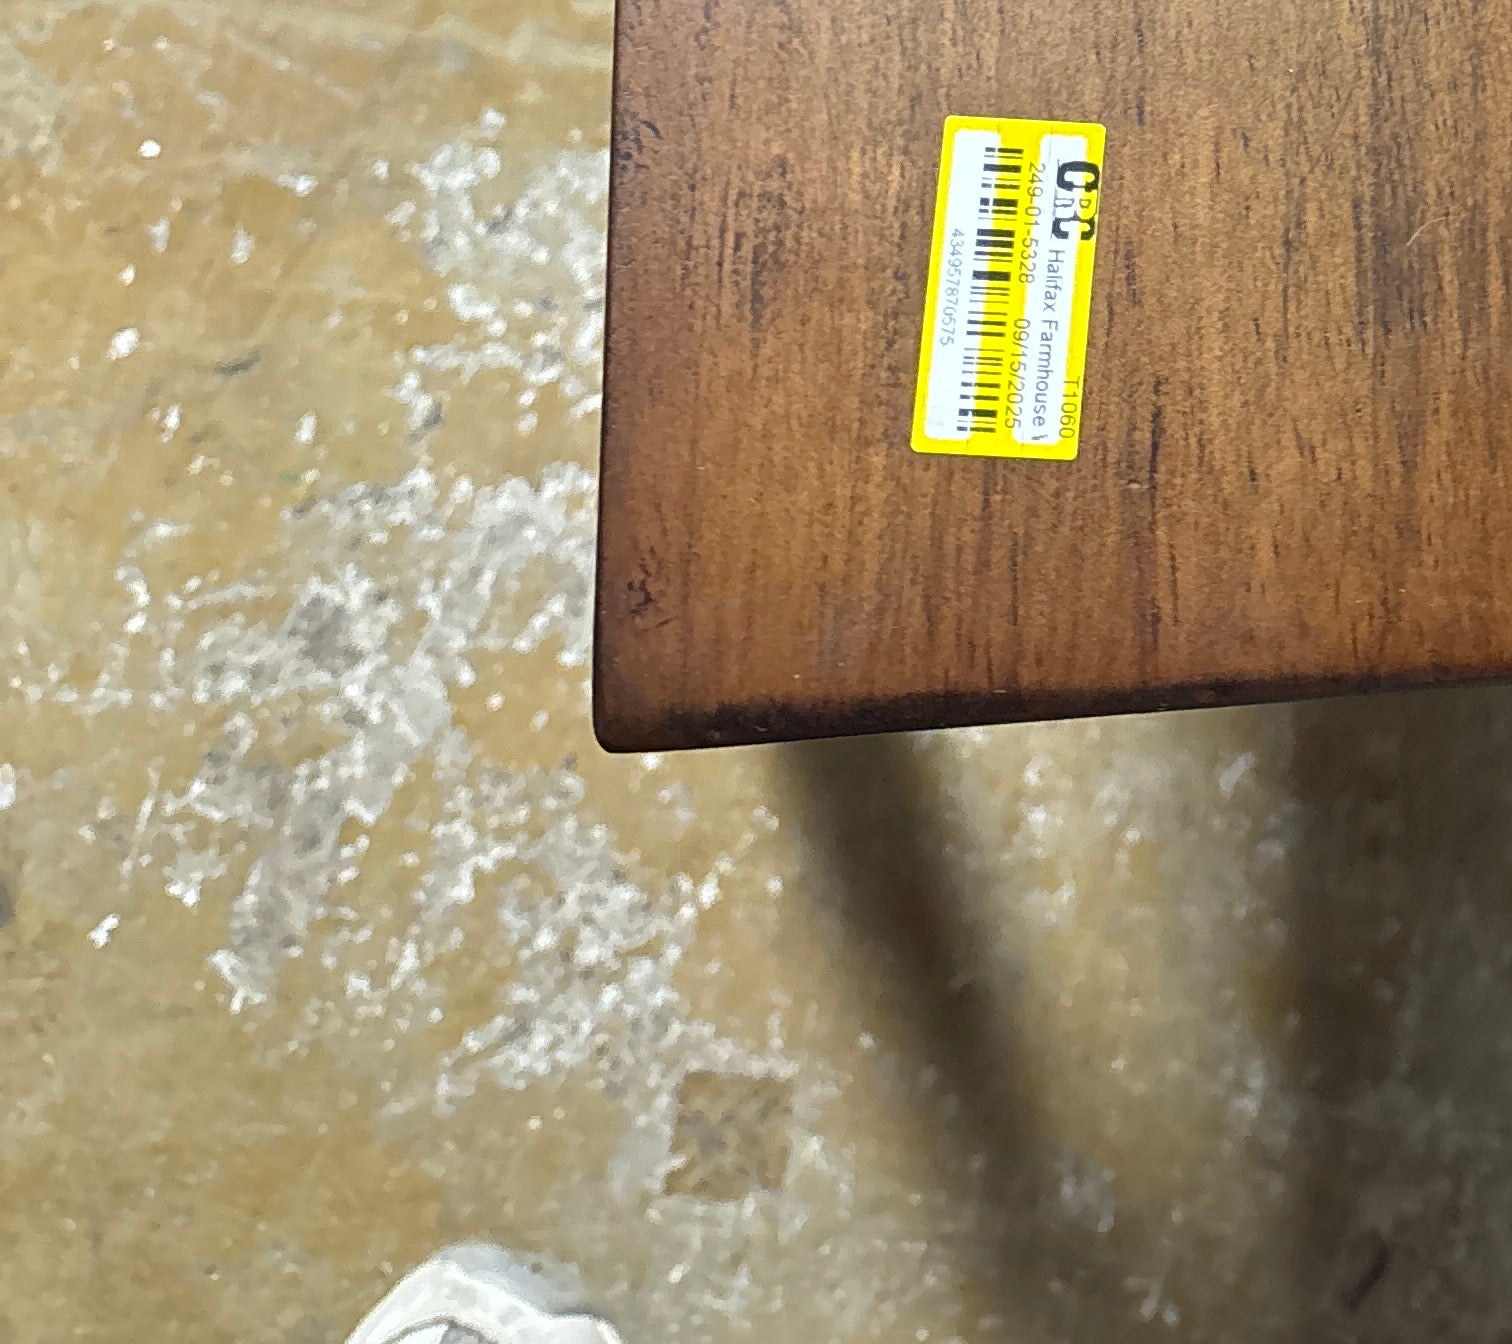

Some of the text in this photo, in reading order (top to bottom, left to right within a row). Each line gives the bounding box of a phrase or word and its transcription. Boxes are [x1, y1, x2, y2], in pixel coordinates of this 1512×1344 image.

[1019, 161, 1046, 284] 249-01-5328
[1042, 249, 1065, 312] Halifax
[1004, 318, 1031, 429] 09/15/2025
[1033, 320, 1055, 427] Farmhouse
[1058, 375, 1080, 439] T1060
